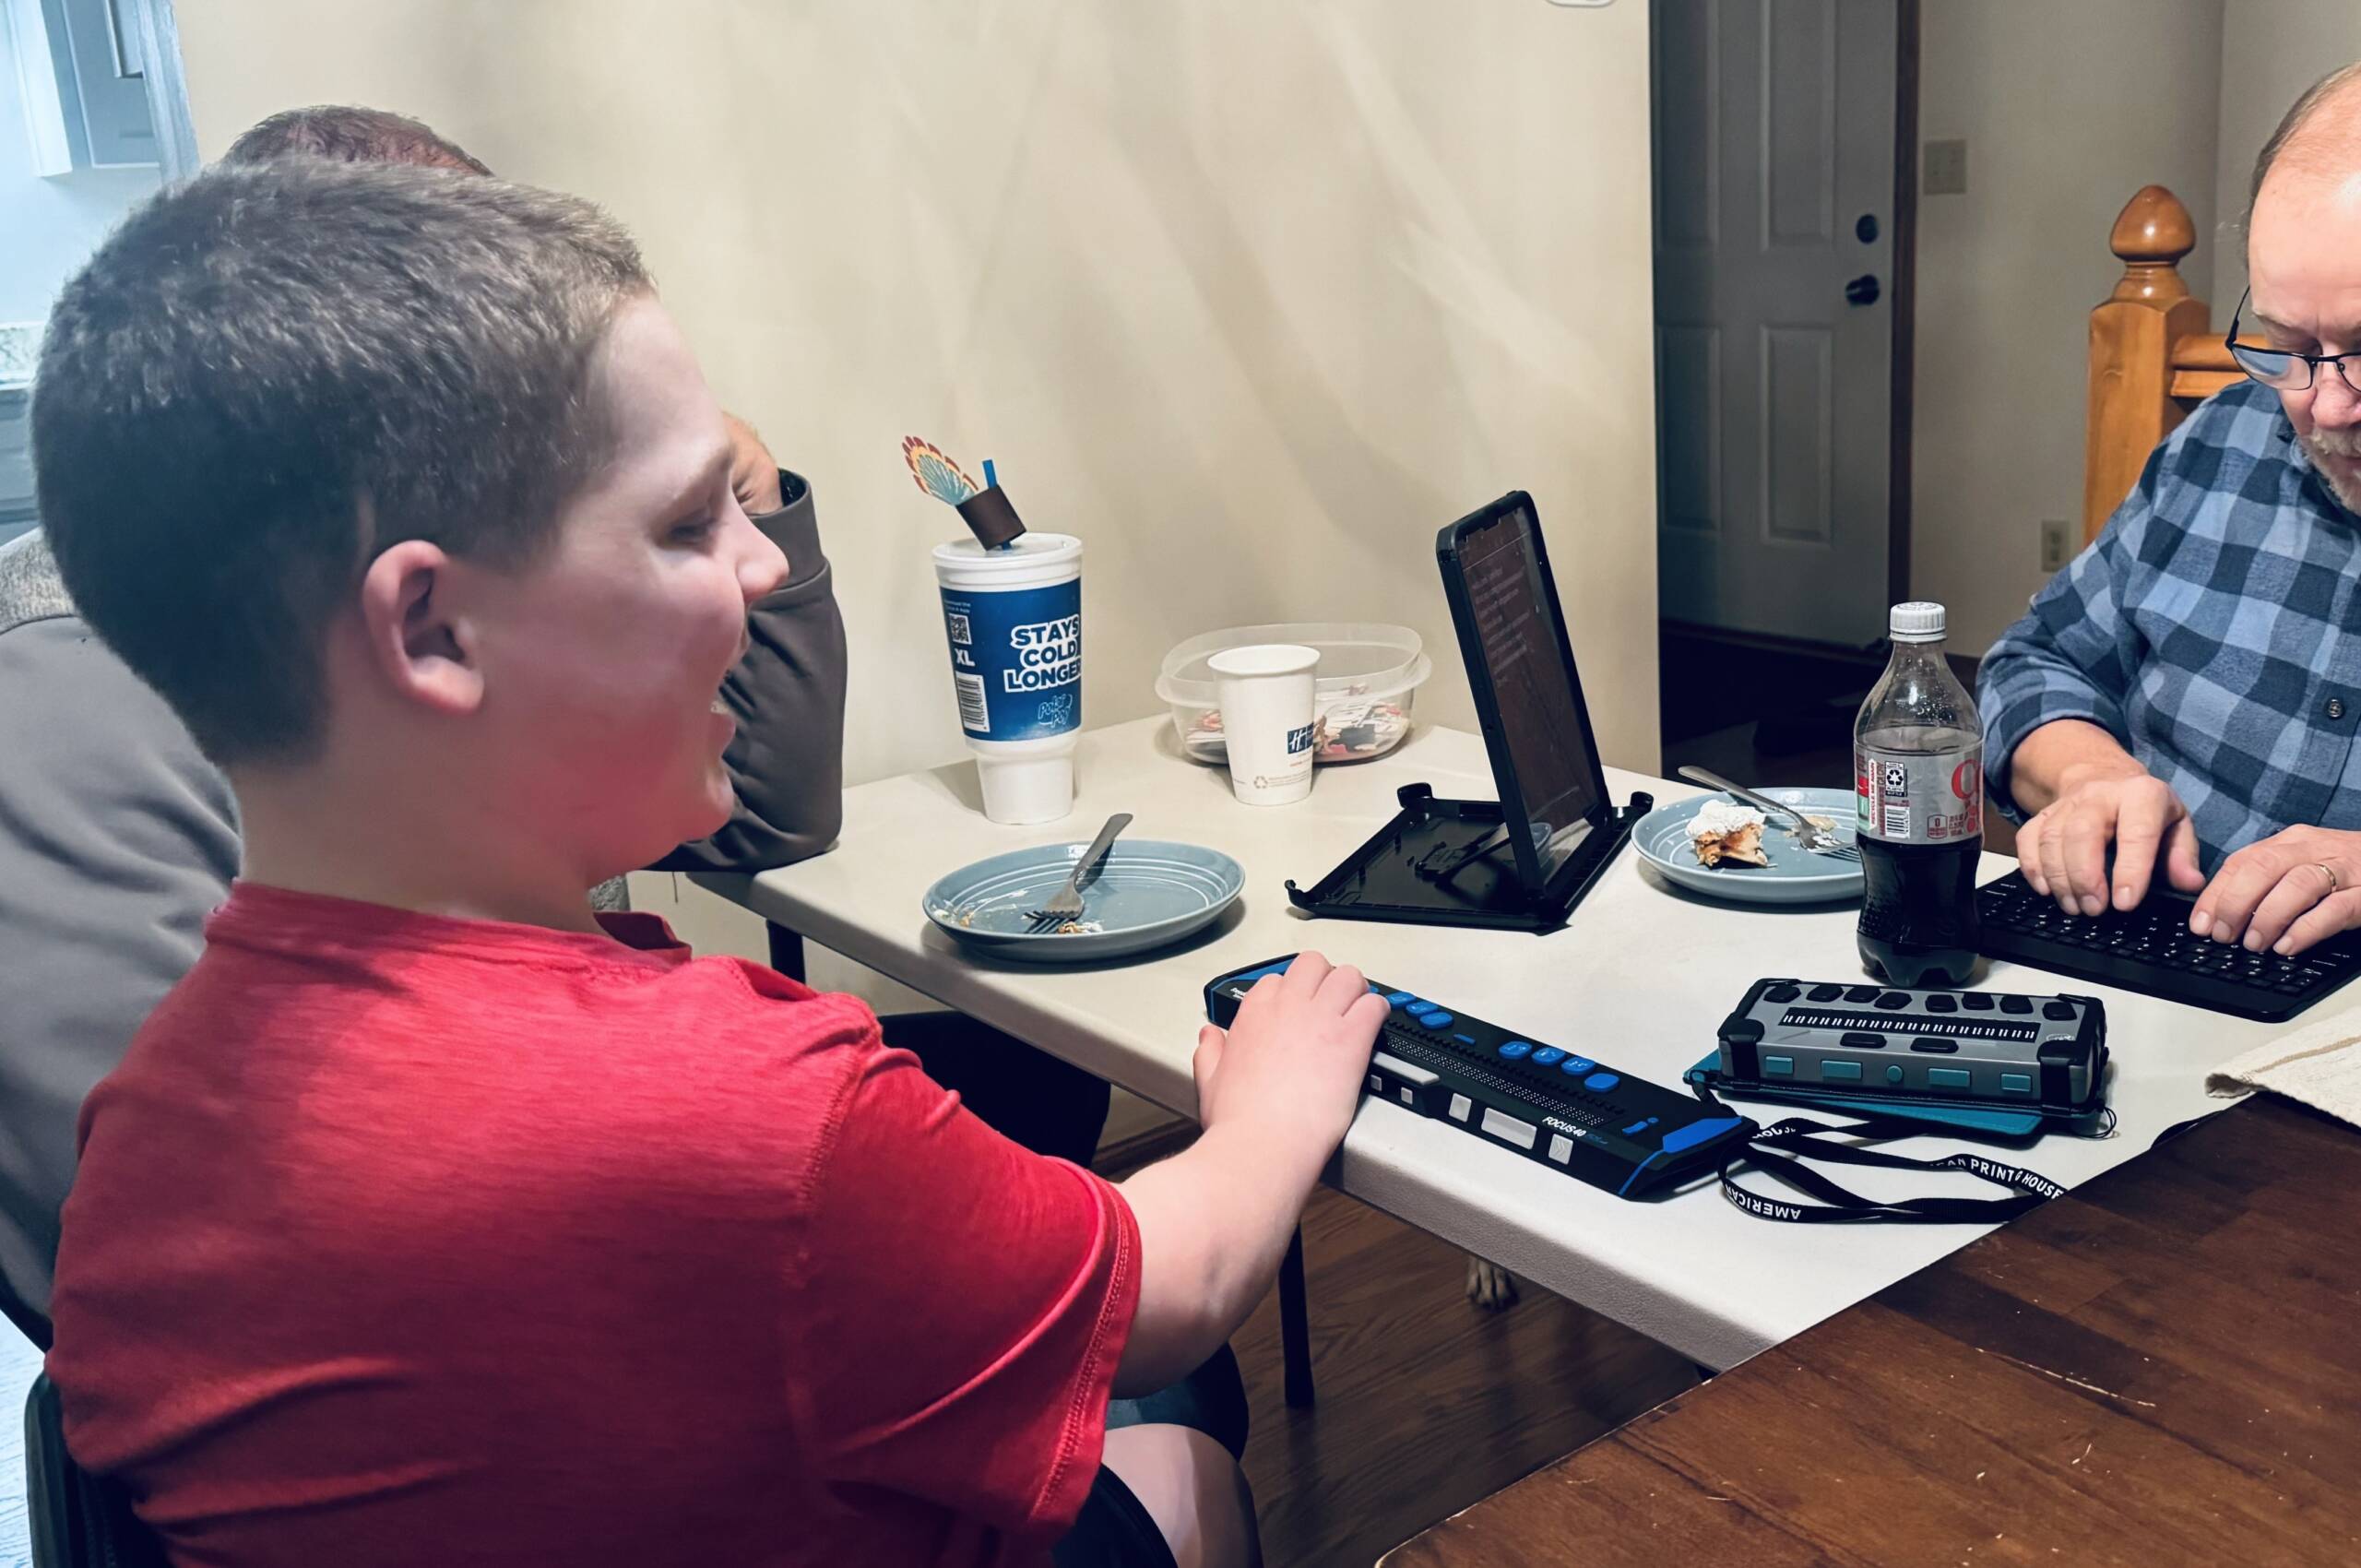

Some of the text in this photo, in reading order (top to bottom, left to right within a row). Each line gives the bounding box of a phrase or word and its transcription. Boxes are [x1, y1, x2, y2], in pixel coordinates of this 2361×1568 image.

[1013, 615, 1079, 647] STAYS
[954, 647, 976, 667] XL
[1022, 640, 1077, 667] COLD
[1542, 1116, 1587, 1137] FOCUS 40
[1725, 1183, 1802, 1220] AMERICAN
